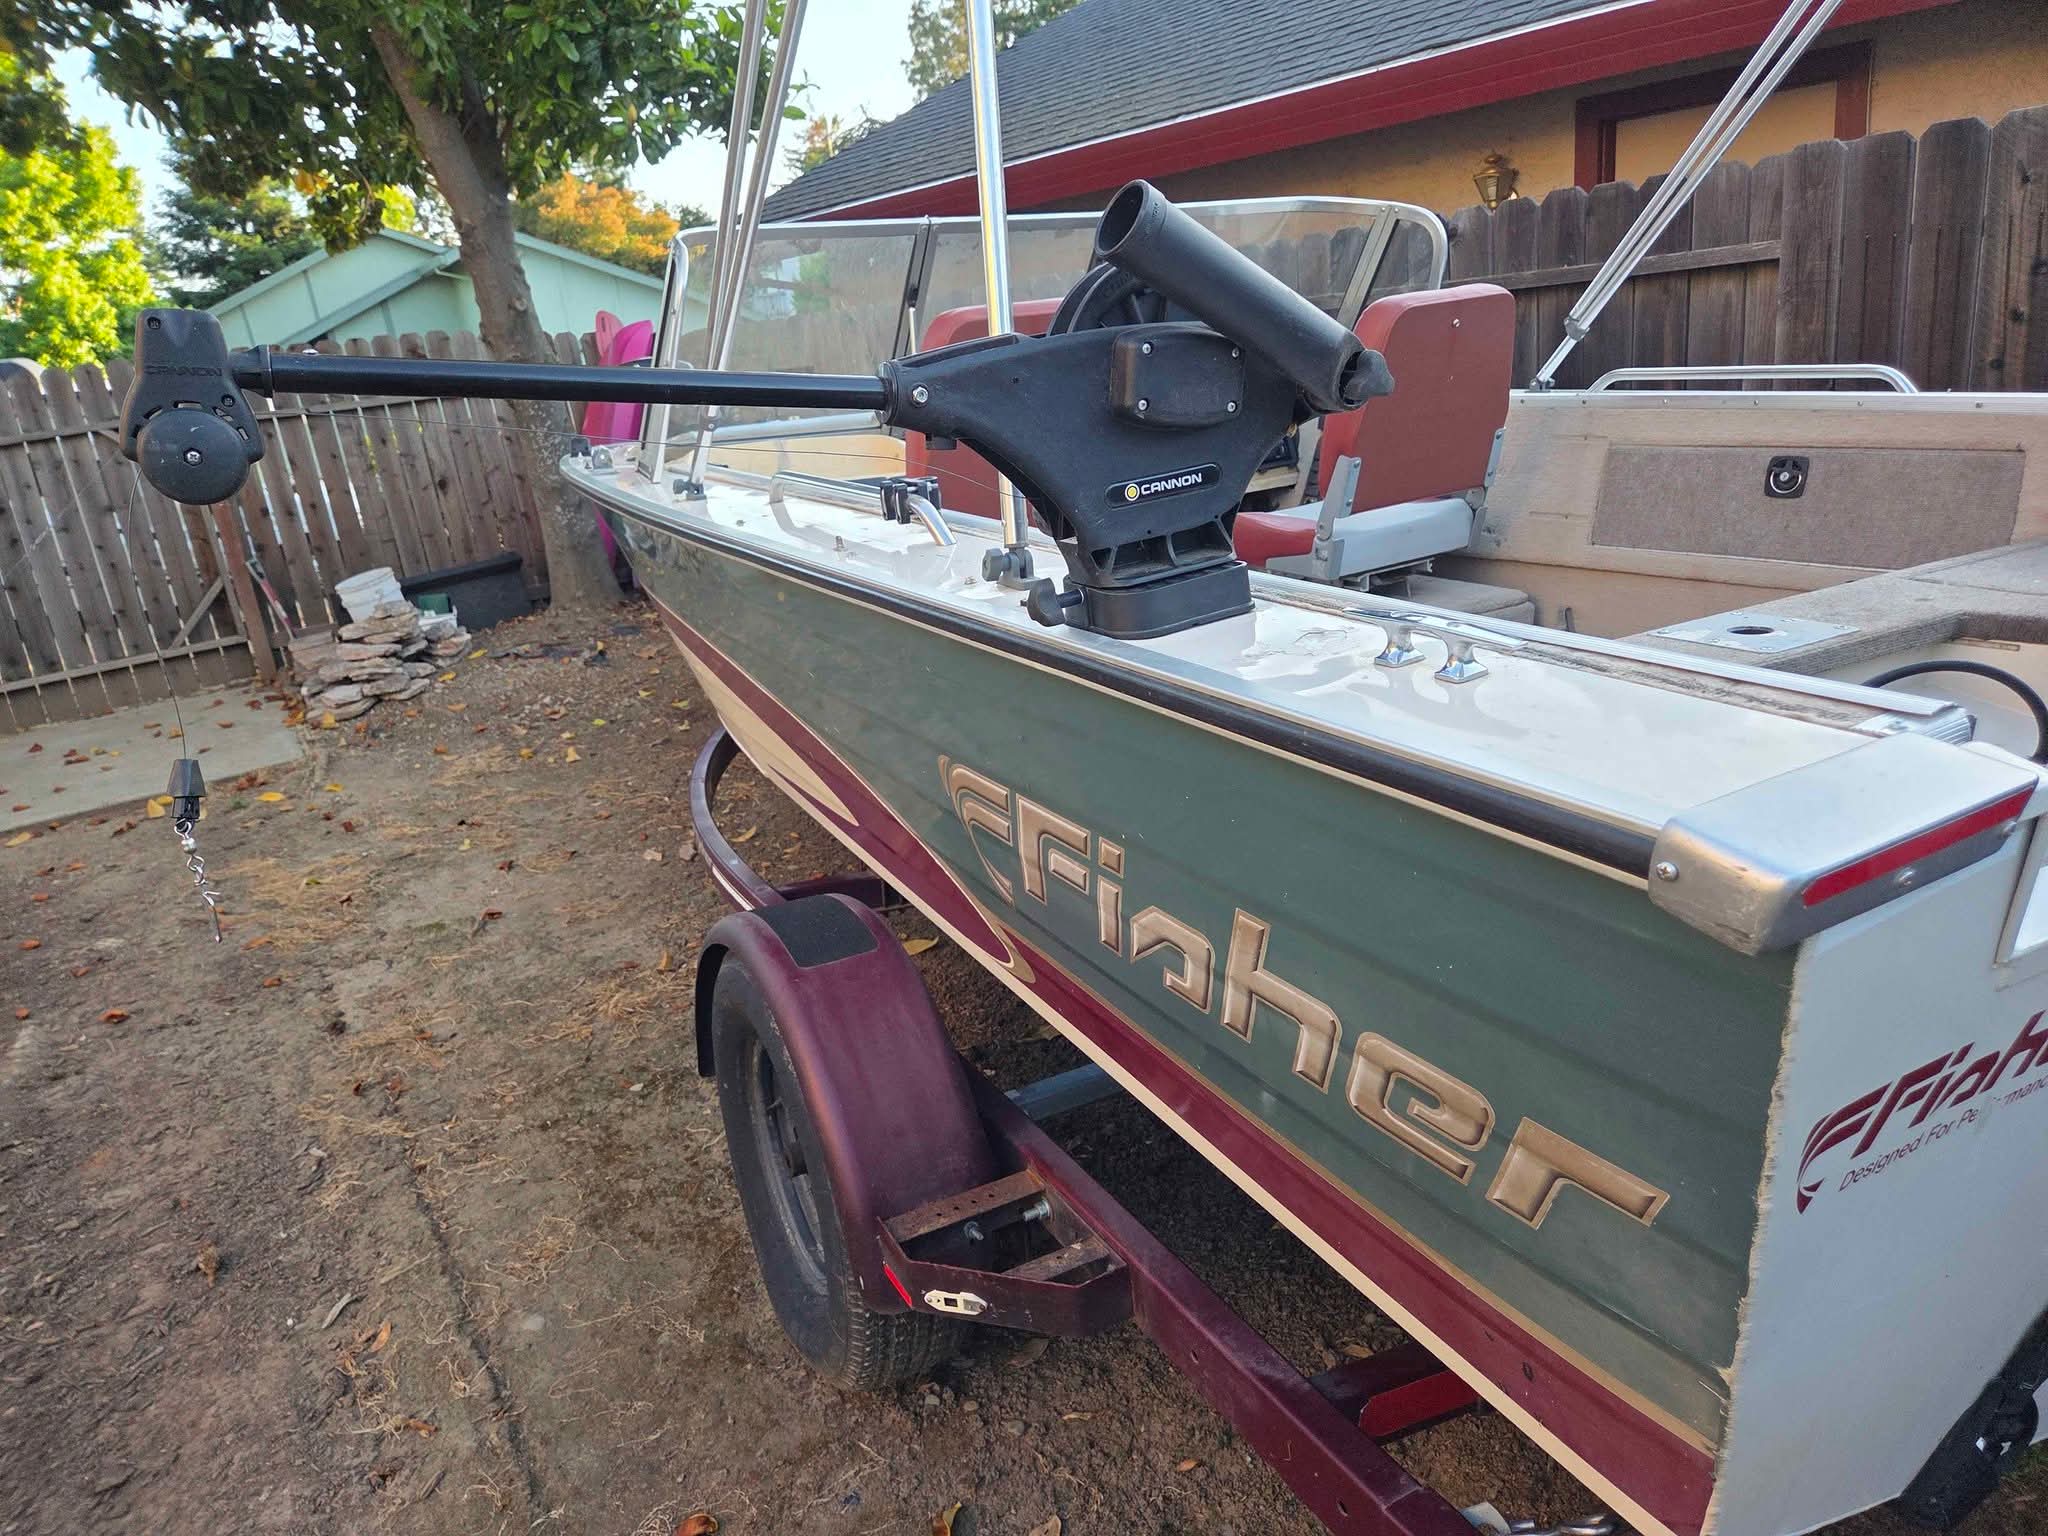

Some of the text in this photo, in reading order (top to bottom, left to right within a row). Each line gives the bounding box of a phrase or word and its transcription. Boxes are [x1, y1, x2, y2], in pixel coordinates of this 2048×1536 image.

[1140, 472, 1202, 495] CANNON
[1015, 790, 1670, 1231] Fisher
[1848, 1009, 2048, 1161] Fish
[1838, 1131, 1926, 1193] Designed
[1925, 1119, 1956, 1145] For
